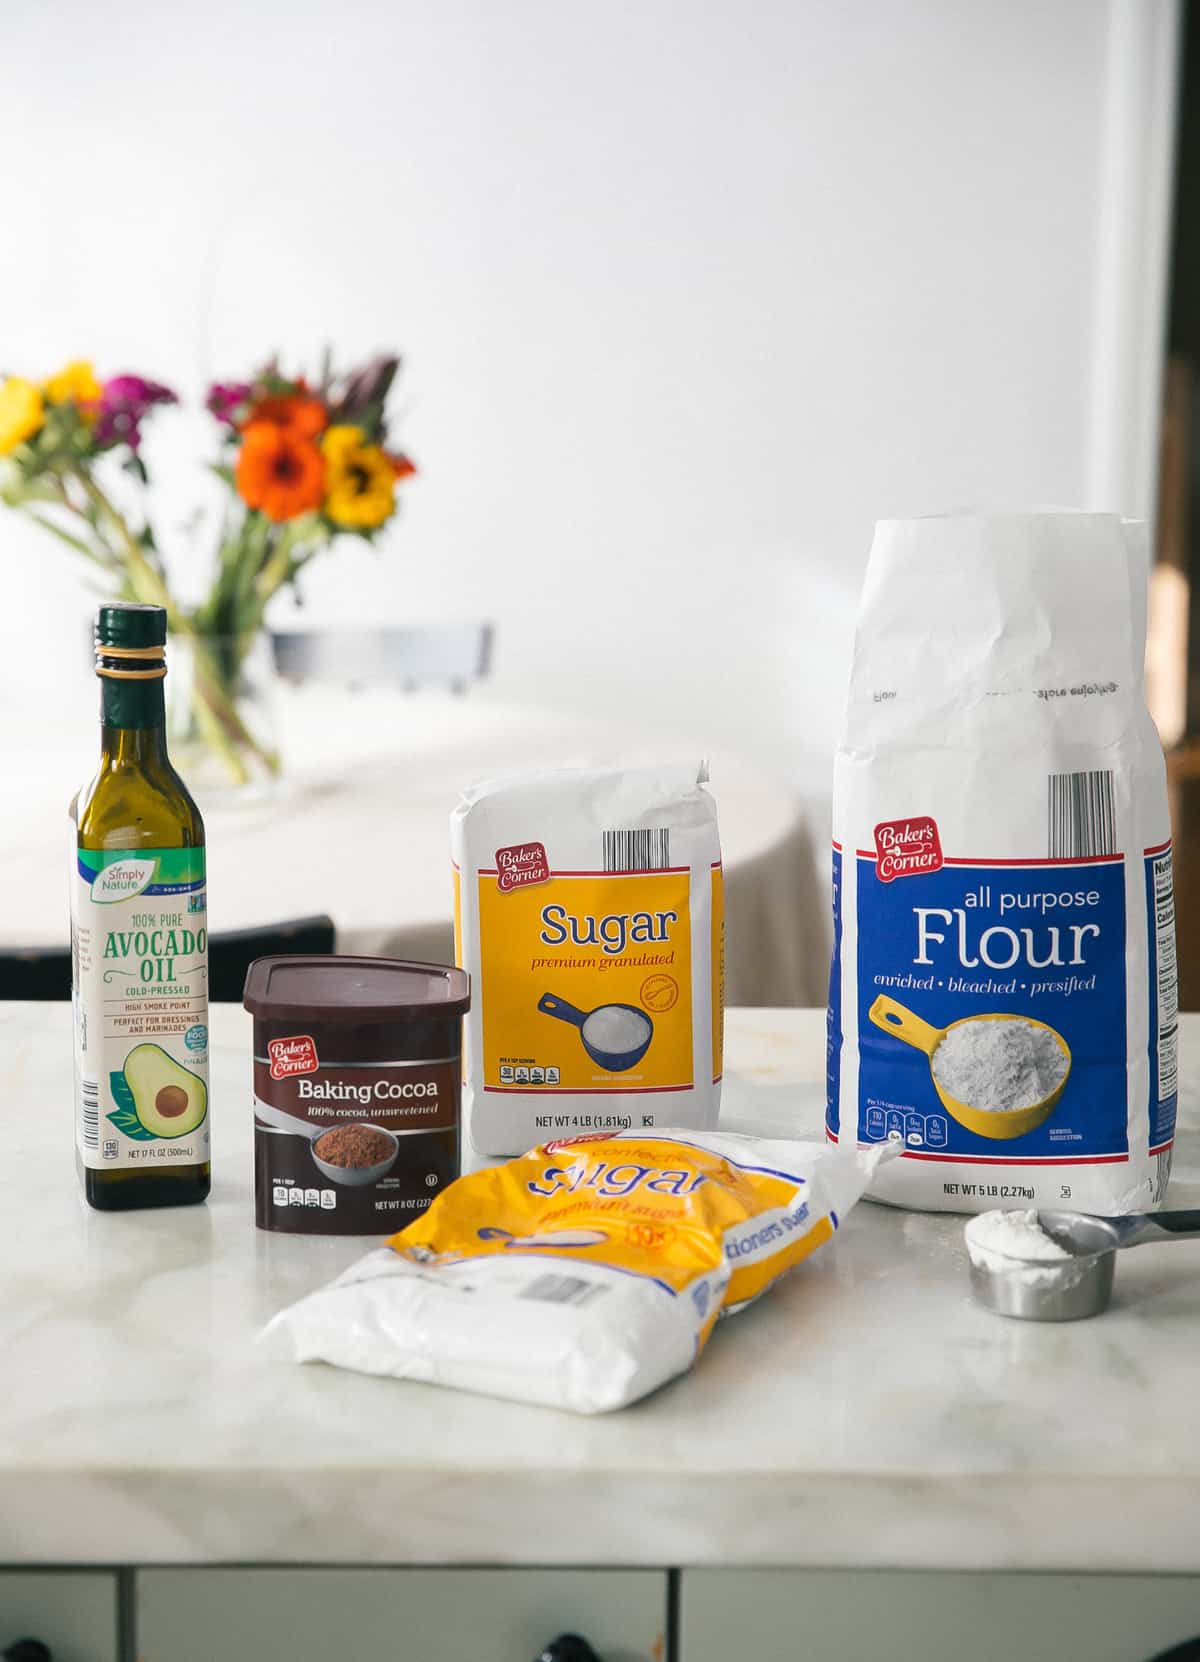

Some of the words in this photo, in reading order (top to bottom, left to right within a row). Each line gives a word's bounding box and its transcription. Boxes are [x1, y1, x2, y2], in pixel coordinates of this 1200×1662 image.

[877, 824, 934, 849] Baker's
[499, 847, 543, 867] Baker's
[880, 851, 936, 877] Corner
[108, 869, 145, 883] Simply
[501, 869, 544, 888] Corner
[102, 879, 138, 891] Nature
[964, 886, 990, 908] all
[1000, 890, 1100, 916] purpose
[132, 914, 156, 928] 100%
[160, 913, 183, 927] PURE
[540, 903, 678, 955] Sugar
[103, 928, 208, 959] AVOCADO
[912, 907, 1101, 969] Flour
[140, 958, 176, 982] OIL
[531, 956, 596, 970] premium
[599, 952, 676, 972] granulated
[125, 985, 190, 997] COLD-PRESSED
[873, 973, 934, 990] enriched
[948, 977, 1017, 994] bleached
[1030, 974, 1096, 997] presifted
[125, 1003, 142, 1011] HIGH
[144, 1002, 168, 1010] SMOKE
[114, 1017, 143, 1026] PERFECT
[146, 1016, 160, 1024] FOR
[161, 1015, 200, 1024] DRESSINGS
[129, 1025, 144, 1033] AND
[145, 1024, 186, 1032] MARINADES
[271, 1040, 312, 1058] Baker's
[273, 1059, 313, 1076] Corner
[298, 1079, 372, 1104] Baking
[374, 1080, 438, 1099] Cocoa
[308, 1106, 334, 1116] 100%
[336, 1108, 369, 1118] cocoa,
[370, 1104, 438, 1118] unsweetened
[536, 1116, 553, 1127] NET
[554, 1116, 570, 1127] WT
[572, 1116, 578, 1126] 4
[580, 1116, 592, 1126] LB
[593, 1116, 632, 1128] (1.81kg)
[128, 1150, 141, 1158] NET
[150, 1149, 156, 1157] FL
[158, 1149, 166, 1157] OZ
[943, 1183, 958, 1194] NET
[961, 1184, 976, 1195] WT
[979, 1184, 986, 1196] 5
[988, 1185, 998, 1196] LB
[1000, 1185, 1035, 1198] (2.27kg)
[406, 1200, 416, 1208] OZ
